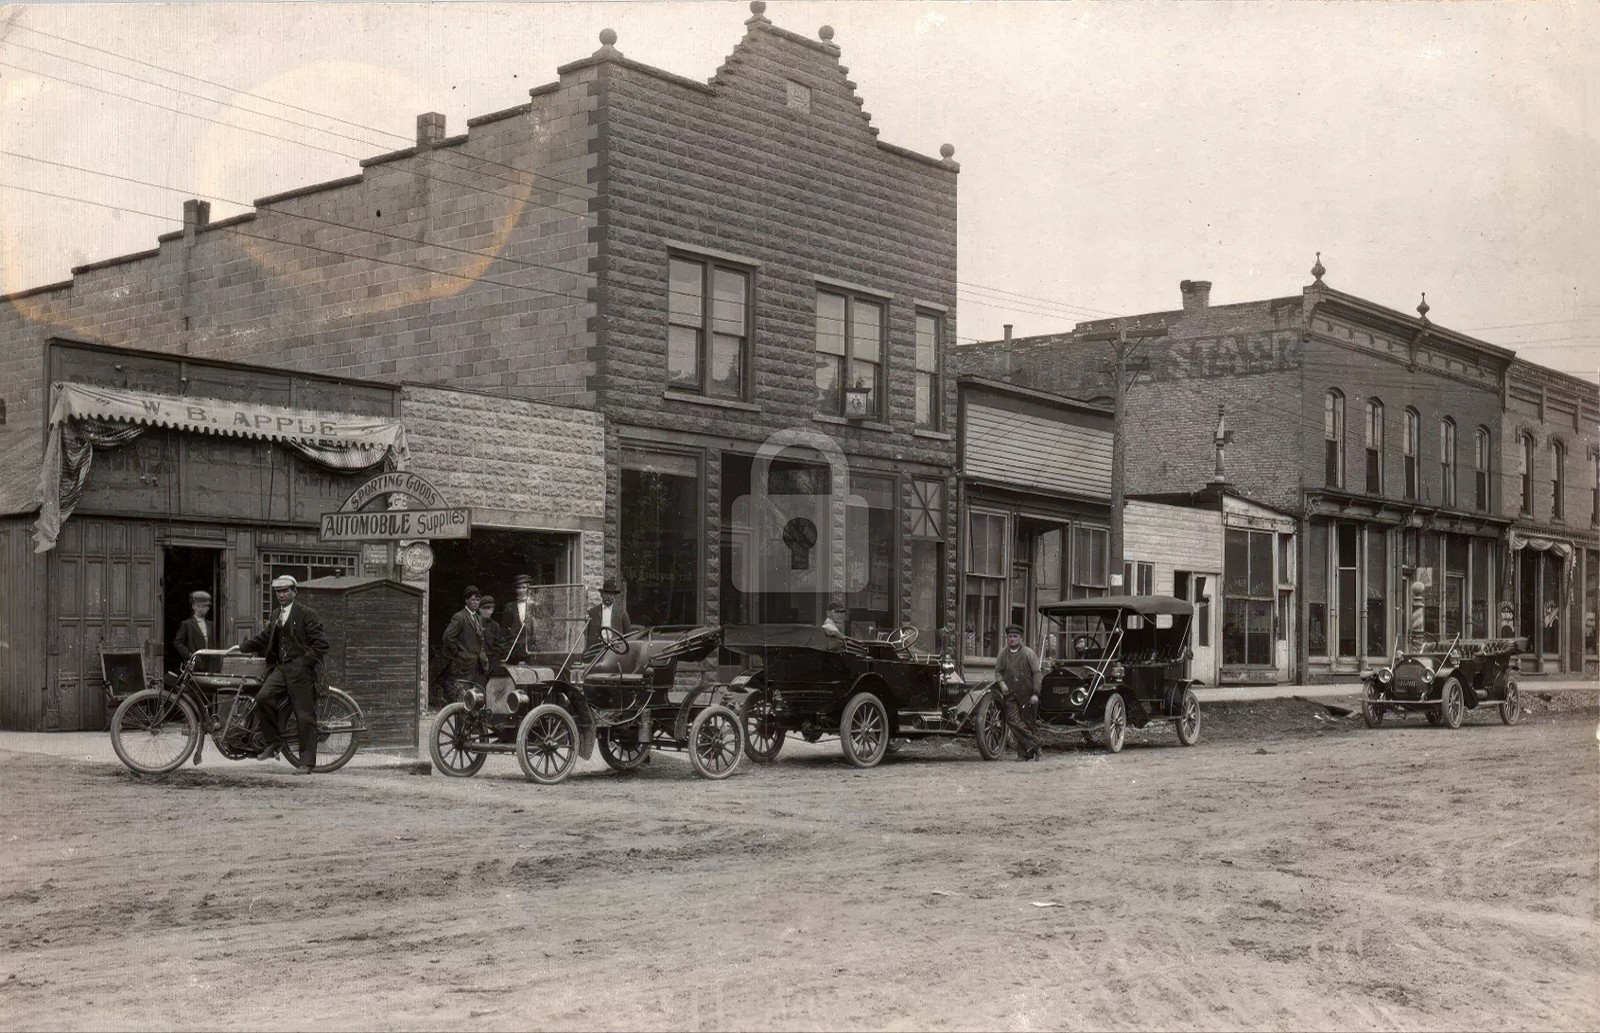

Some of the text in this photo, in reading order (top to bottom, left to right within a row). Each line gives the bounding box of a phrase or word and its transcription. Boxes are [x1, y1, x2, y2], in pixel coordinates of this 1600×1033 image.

[141, 399, 338, 437] W. B. APPLE
[350, 473, 437, 510] SPORTING GOODS
[323, 513, 411, 538] AUTOMOBILE
